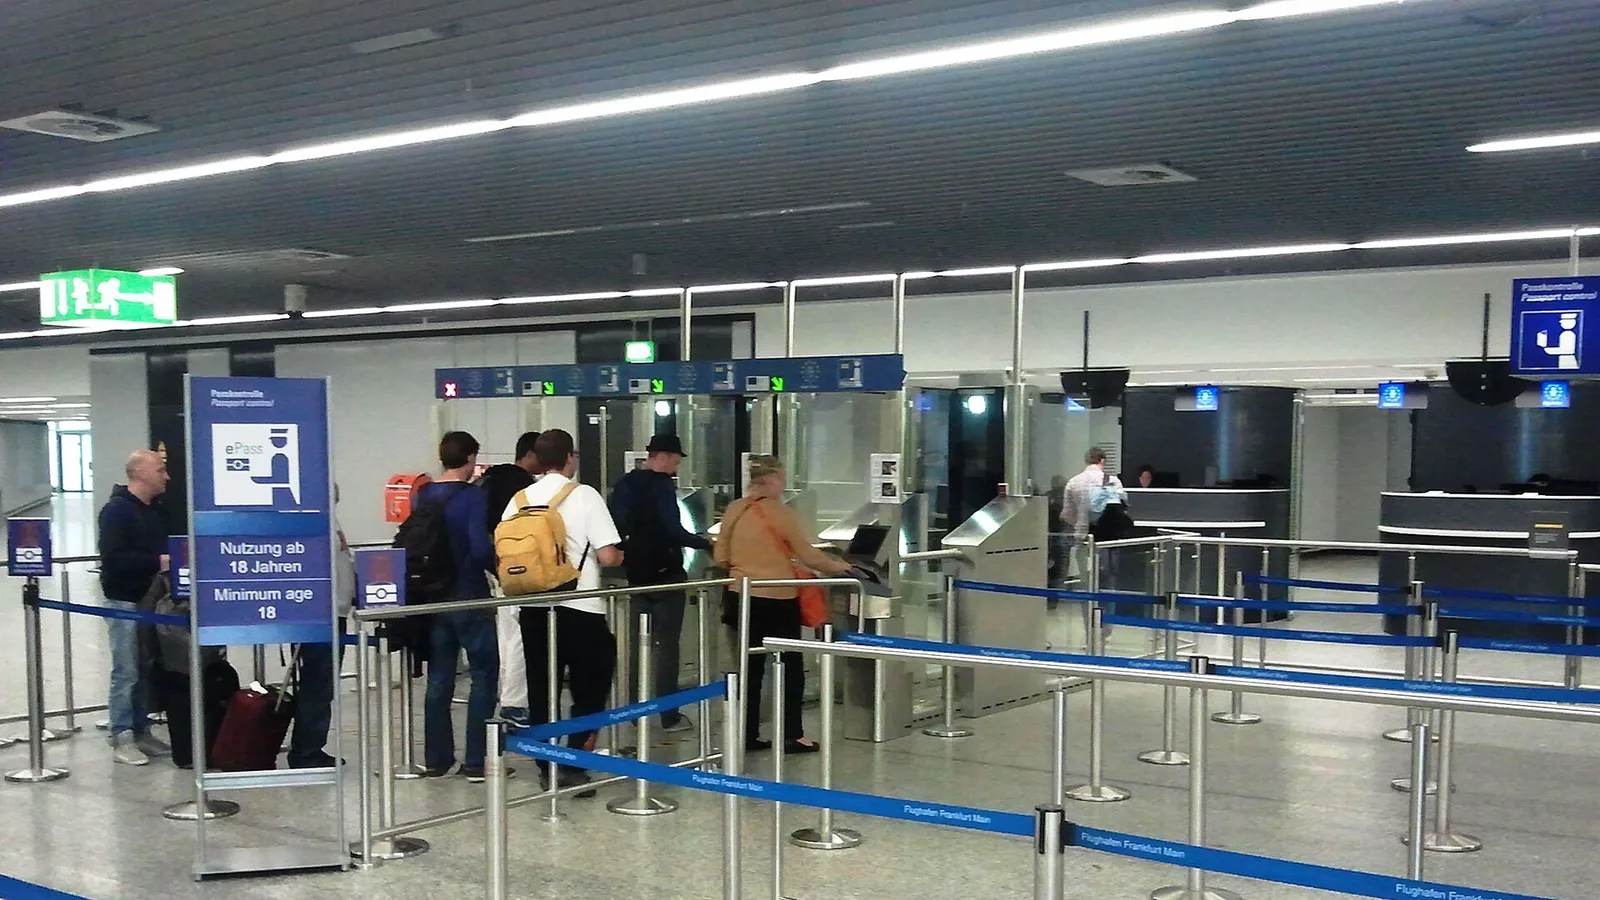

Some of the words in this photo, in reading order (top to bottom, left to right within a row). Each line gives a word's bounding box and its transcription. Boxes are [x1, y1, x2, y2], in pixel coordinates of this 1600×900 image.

[1521, 293, 1562, 302] Passport
[1563, 291, 1598, 300] control
[225, 441, 264, 455] ePass
[220, 541, 283, 557] Nutzung
[285, 541, 305, 554] ab
[229, 560, 249, 574] 18
[251, 560, 302, 573] Jahren
[214, 587, 281, 601] Minimum
[285, 589, 313, 603] age
[258, 605, 277, 619] 18
[973, 814, 992, 824] Main
[1081, 832, 1122, 846] Flughafen
[1123, 840, 1162, 854] Frankfurt
[1163, 847, 1185, 859] Main
[1395, 883, 1446, 900] Flughafen
